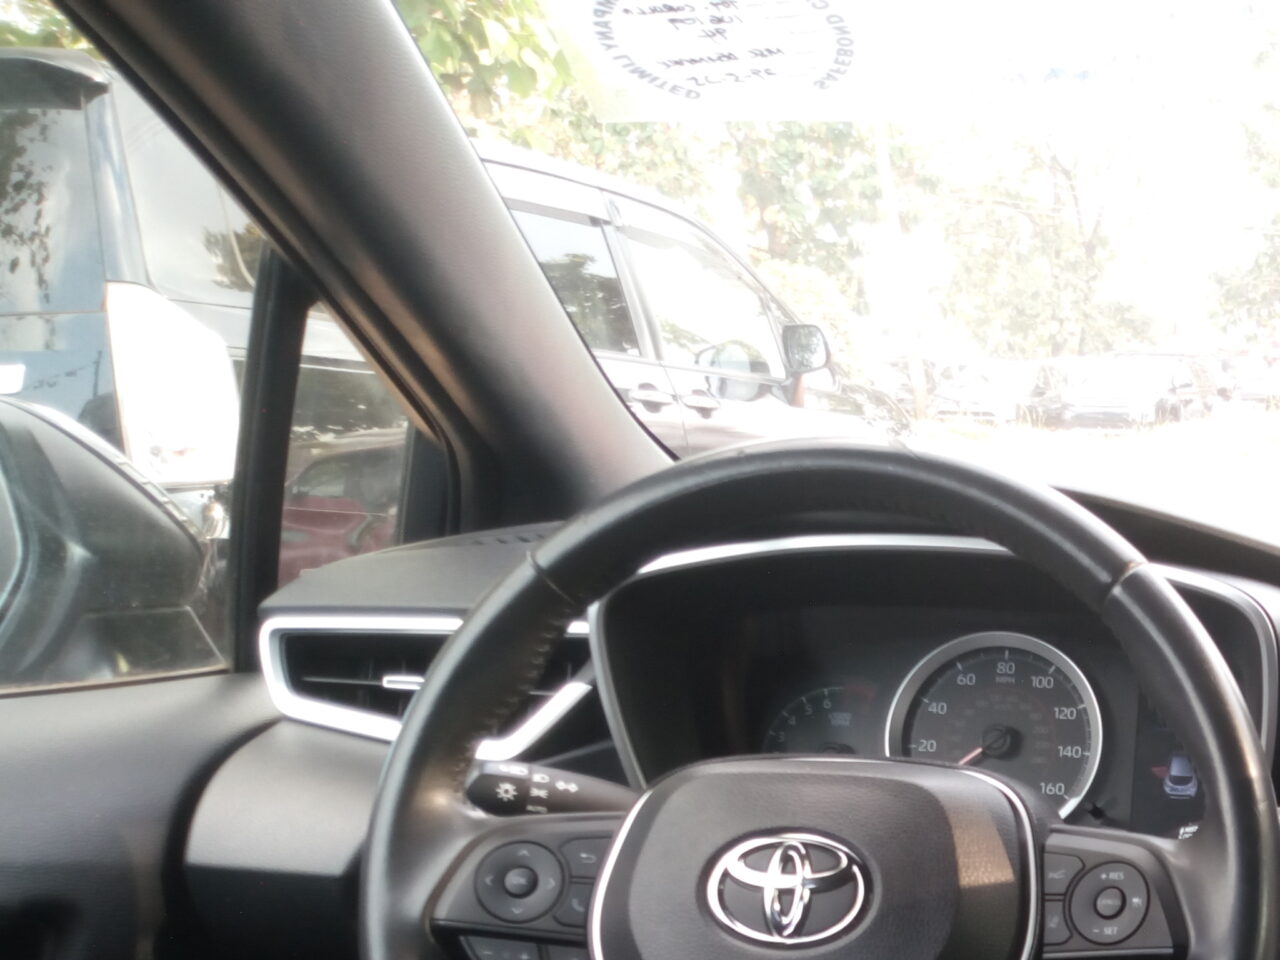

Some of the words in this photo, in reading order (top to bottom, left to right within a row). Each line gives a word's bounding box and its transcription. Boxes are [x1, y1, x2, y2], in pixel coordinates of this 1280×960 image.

[995, 662, 1016, 675] 80
[956, 673, 977, 686] 60
[1030, 675, 1055, 690] 100
[928, 701, 948, 715] 40
[1053, 707, 1077, 721] 120
[917, 739, 937, 752] 20
[1057, 745, 1082, 758] 140
[1040, 782, 1065, 796] 160
